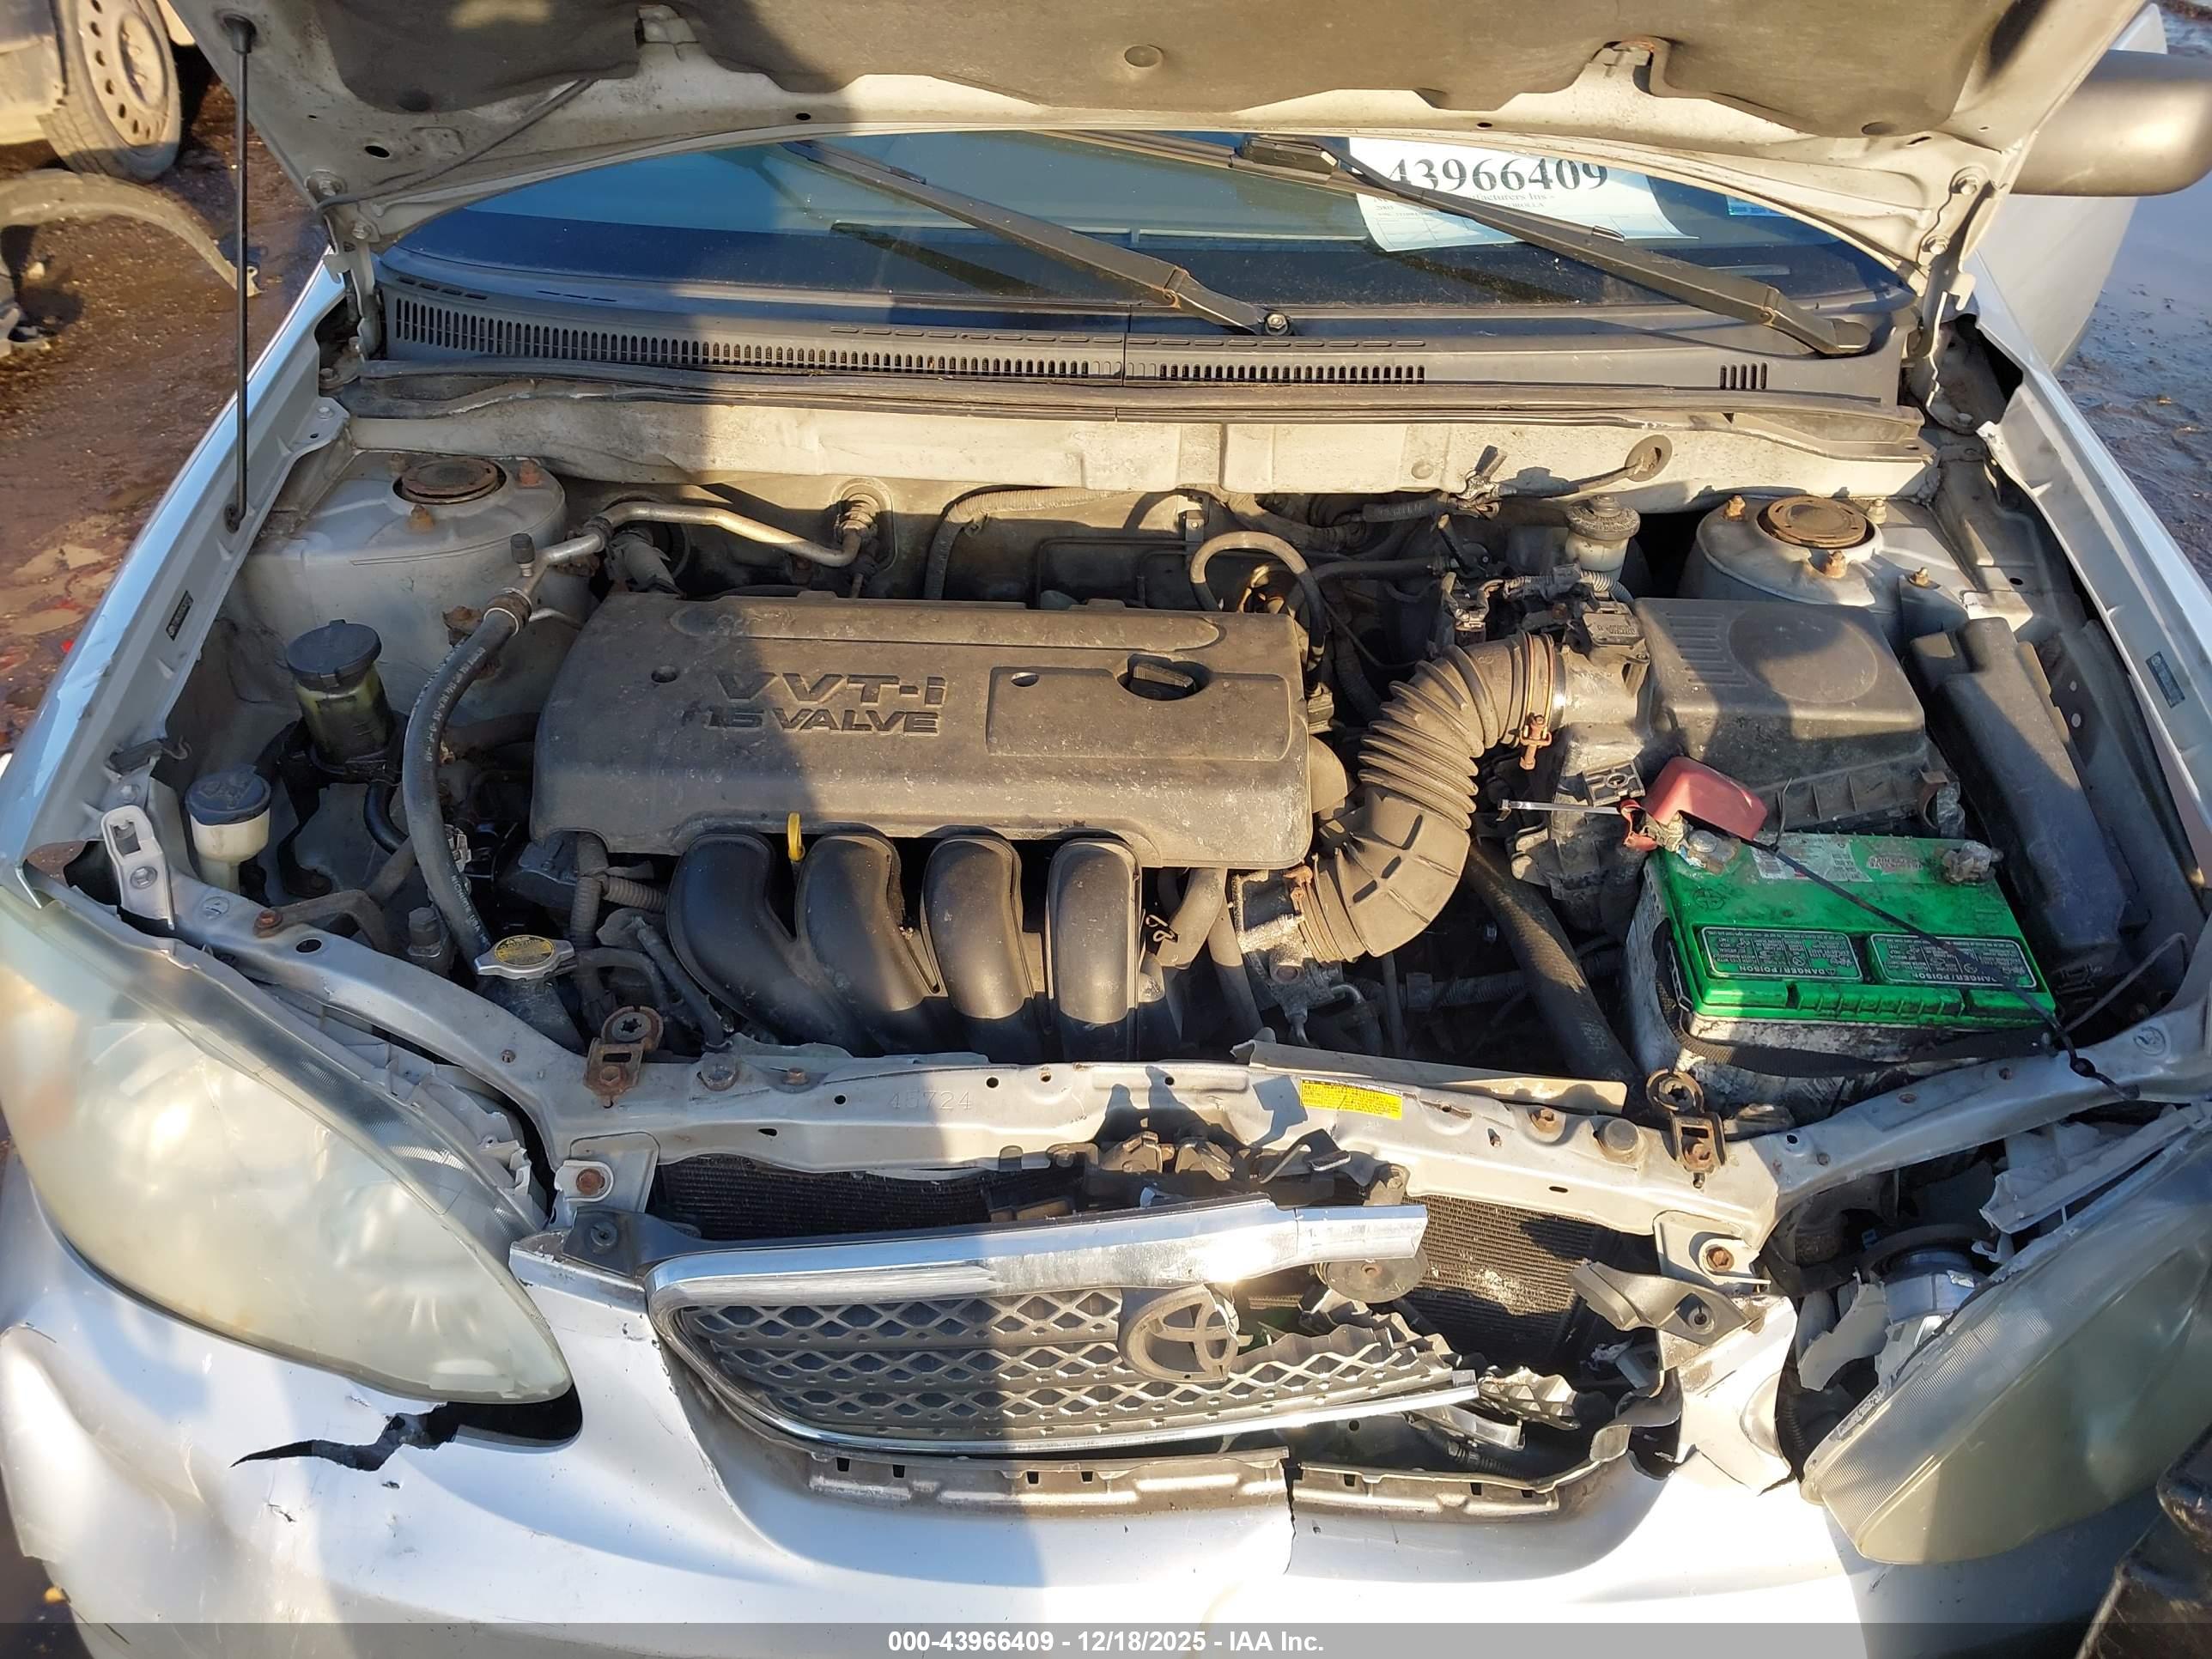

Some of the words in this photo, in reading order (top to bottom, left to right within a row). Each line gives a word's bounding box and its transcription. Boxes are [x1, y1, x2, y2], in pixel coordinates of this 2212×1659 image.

[1389, 157, 1608, 191] 43966409
[715, 672, 946, 708] VVT-i
[772, 708, 940, 736] VALVE
